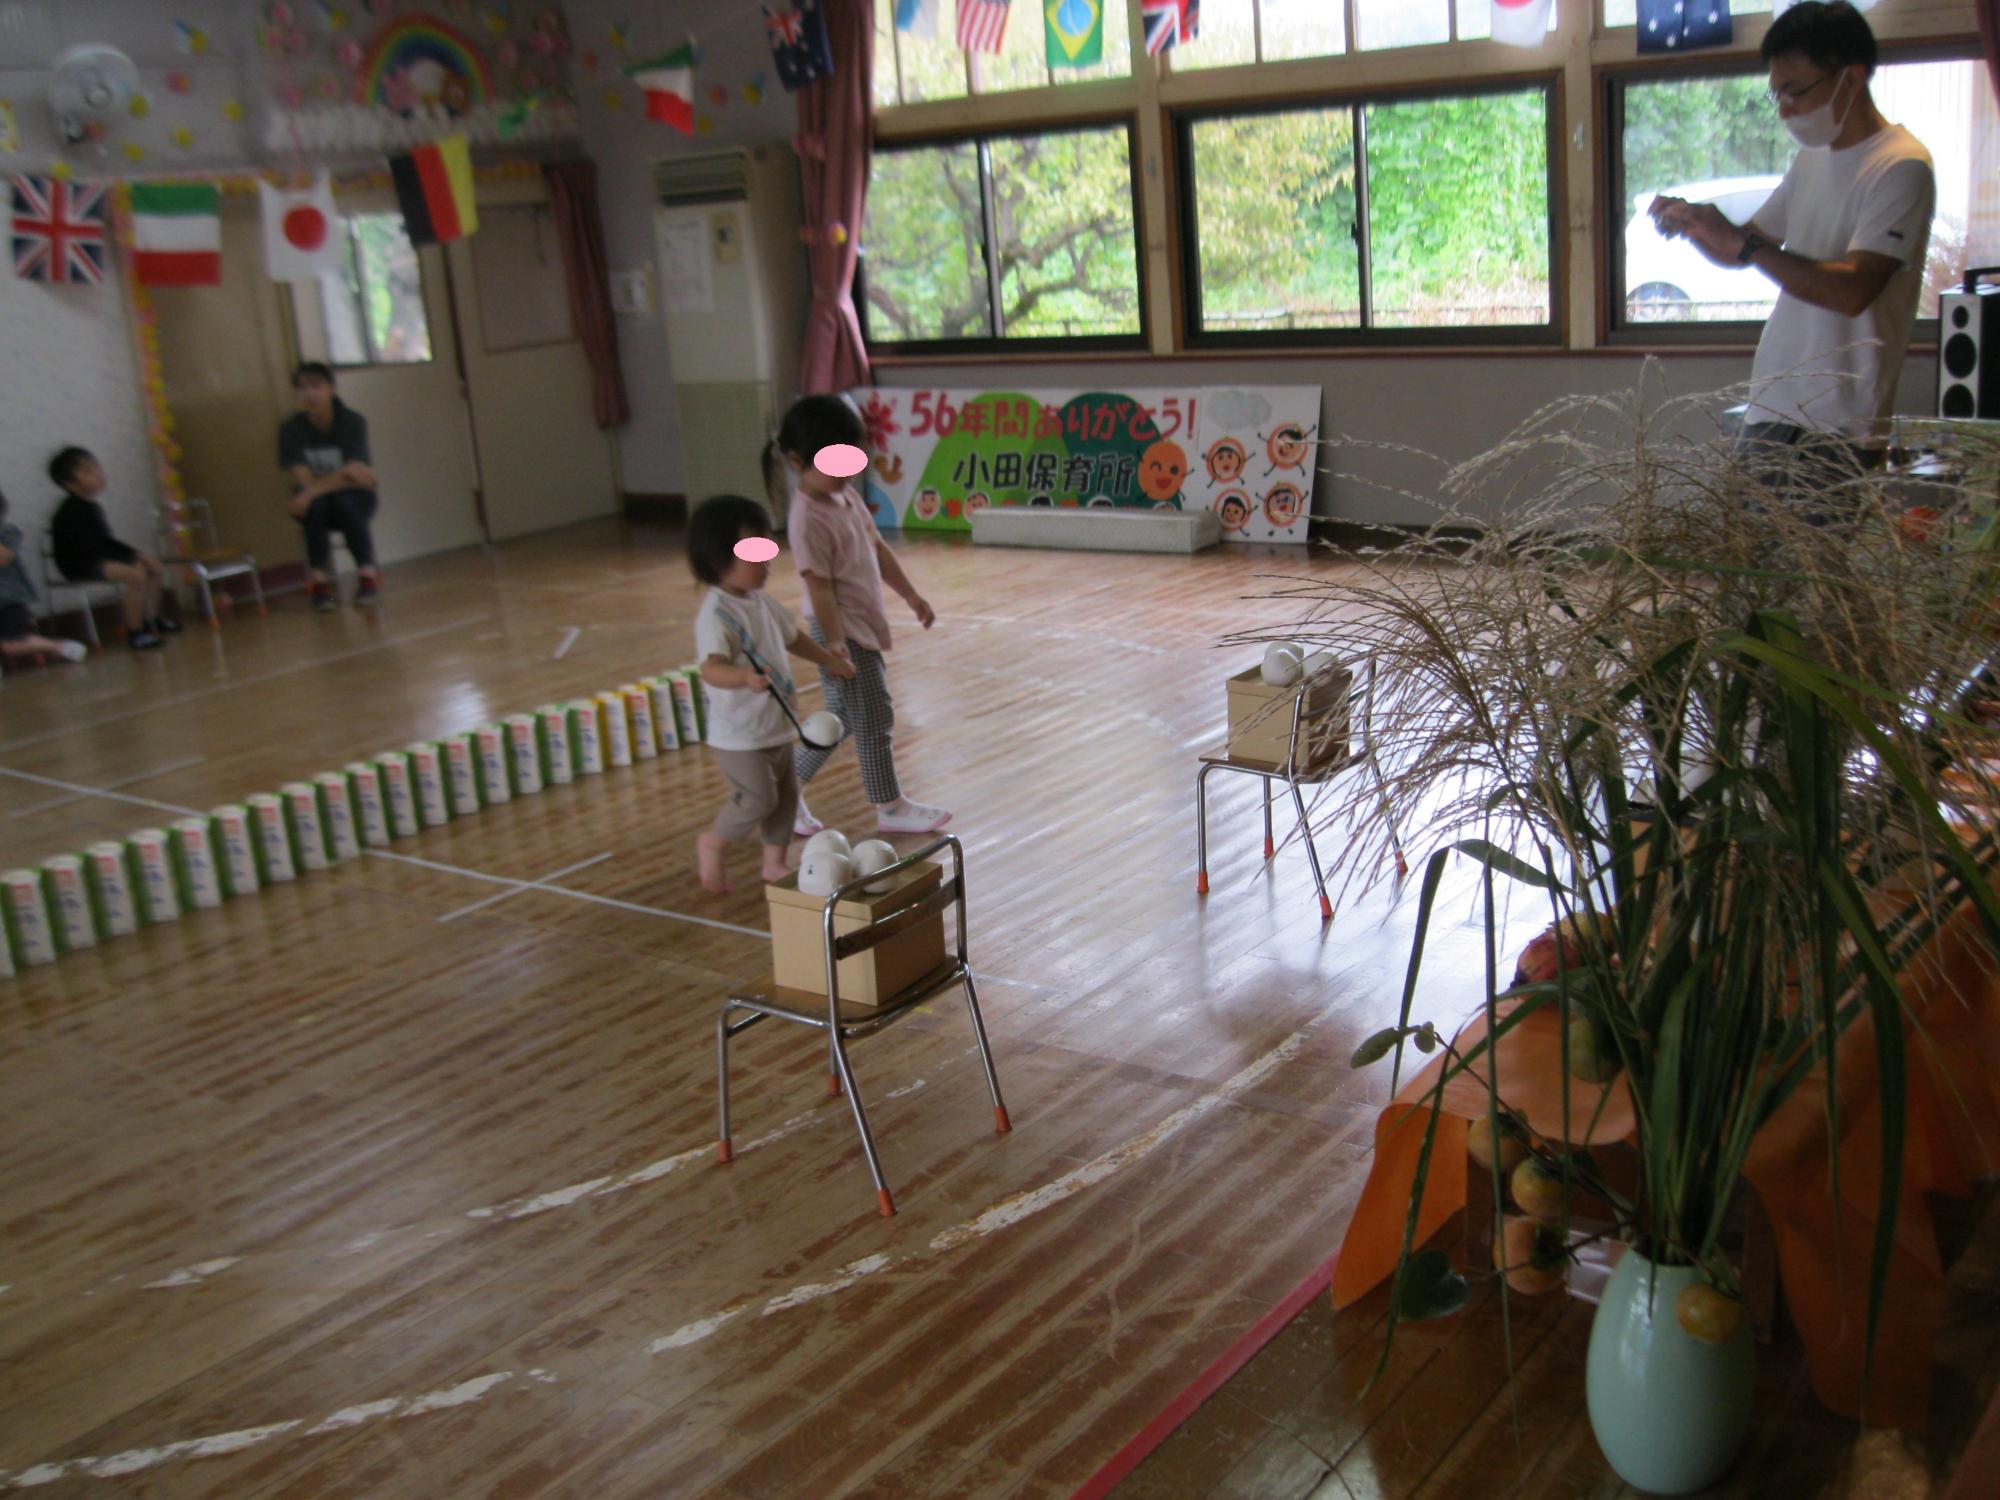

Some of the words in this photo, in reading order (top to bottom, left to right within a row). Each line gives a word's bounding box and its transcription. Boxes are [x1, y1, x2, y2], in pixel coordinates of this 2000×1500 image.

[953, 453, 1135, 496] 小田保育所
